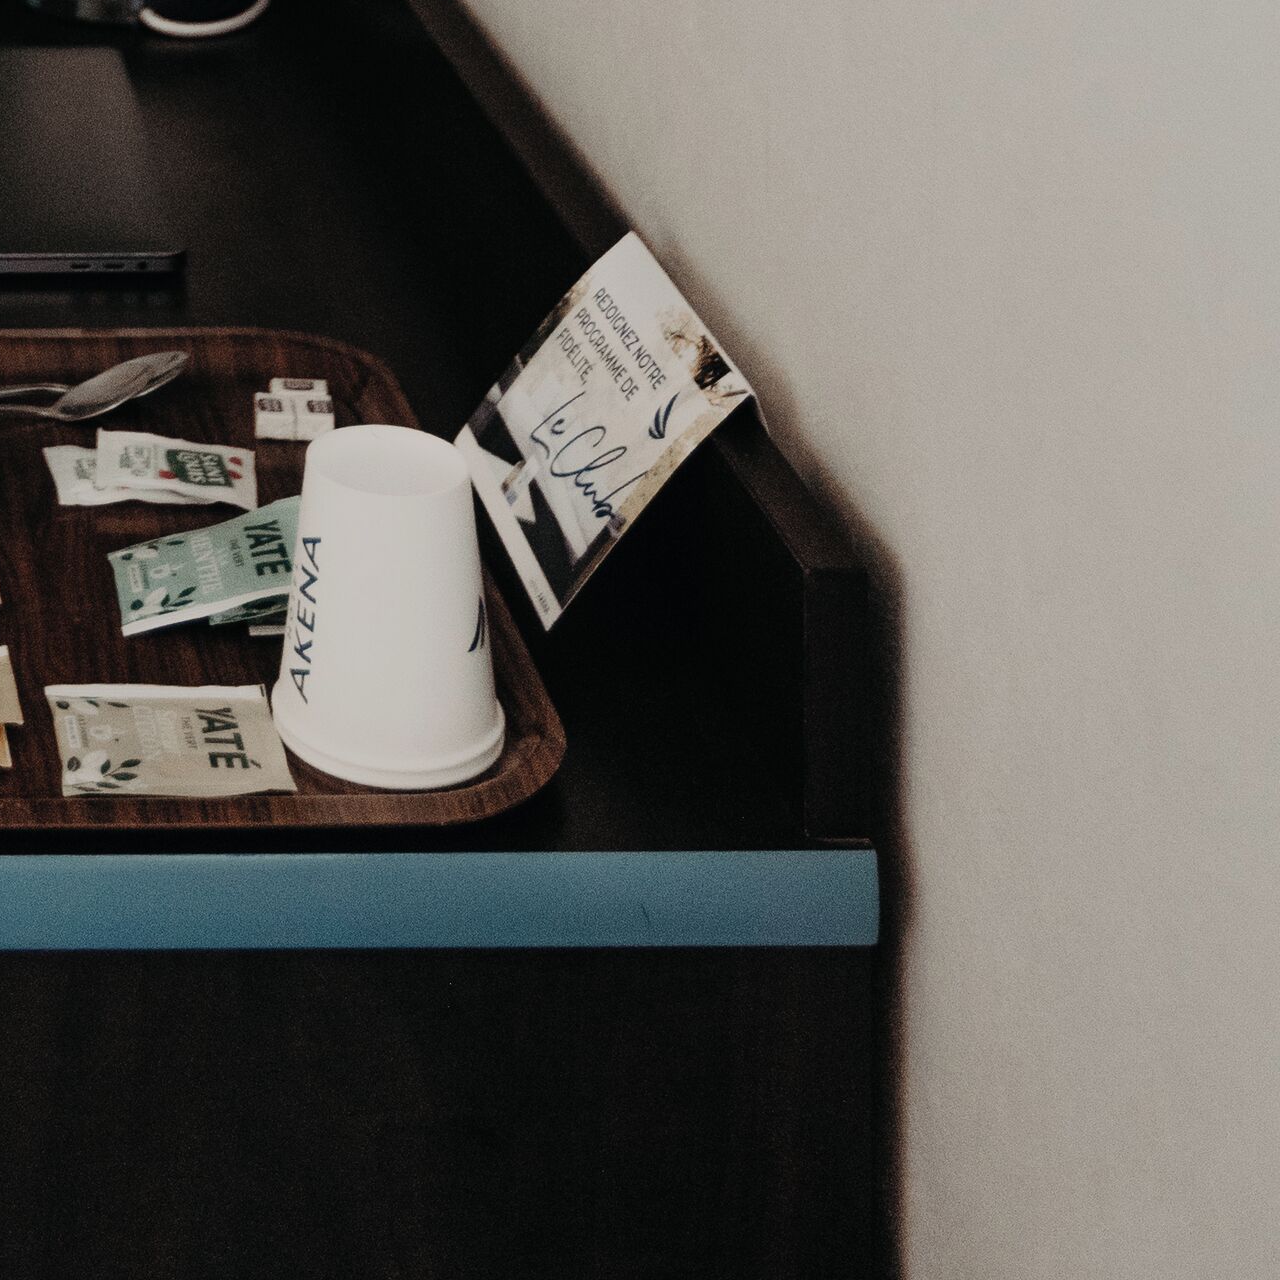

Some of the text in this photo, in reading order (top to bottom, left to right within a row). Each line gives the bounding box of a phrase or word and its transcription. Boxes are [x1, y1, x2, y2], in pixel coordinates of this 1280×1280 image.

[556, 327, 595, 386] FIDÉLITÉ,
[574, 307, 640, 402] PROGRAMME DE
[592, 287, 667, 391] REJOIGNEZ NOTRE
[290, 536, 322, 704] AKENA
[195, 707, 262, 769] YATÉ
